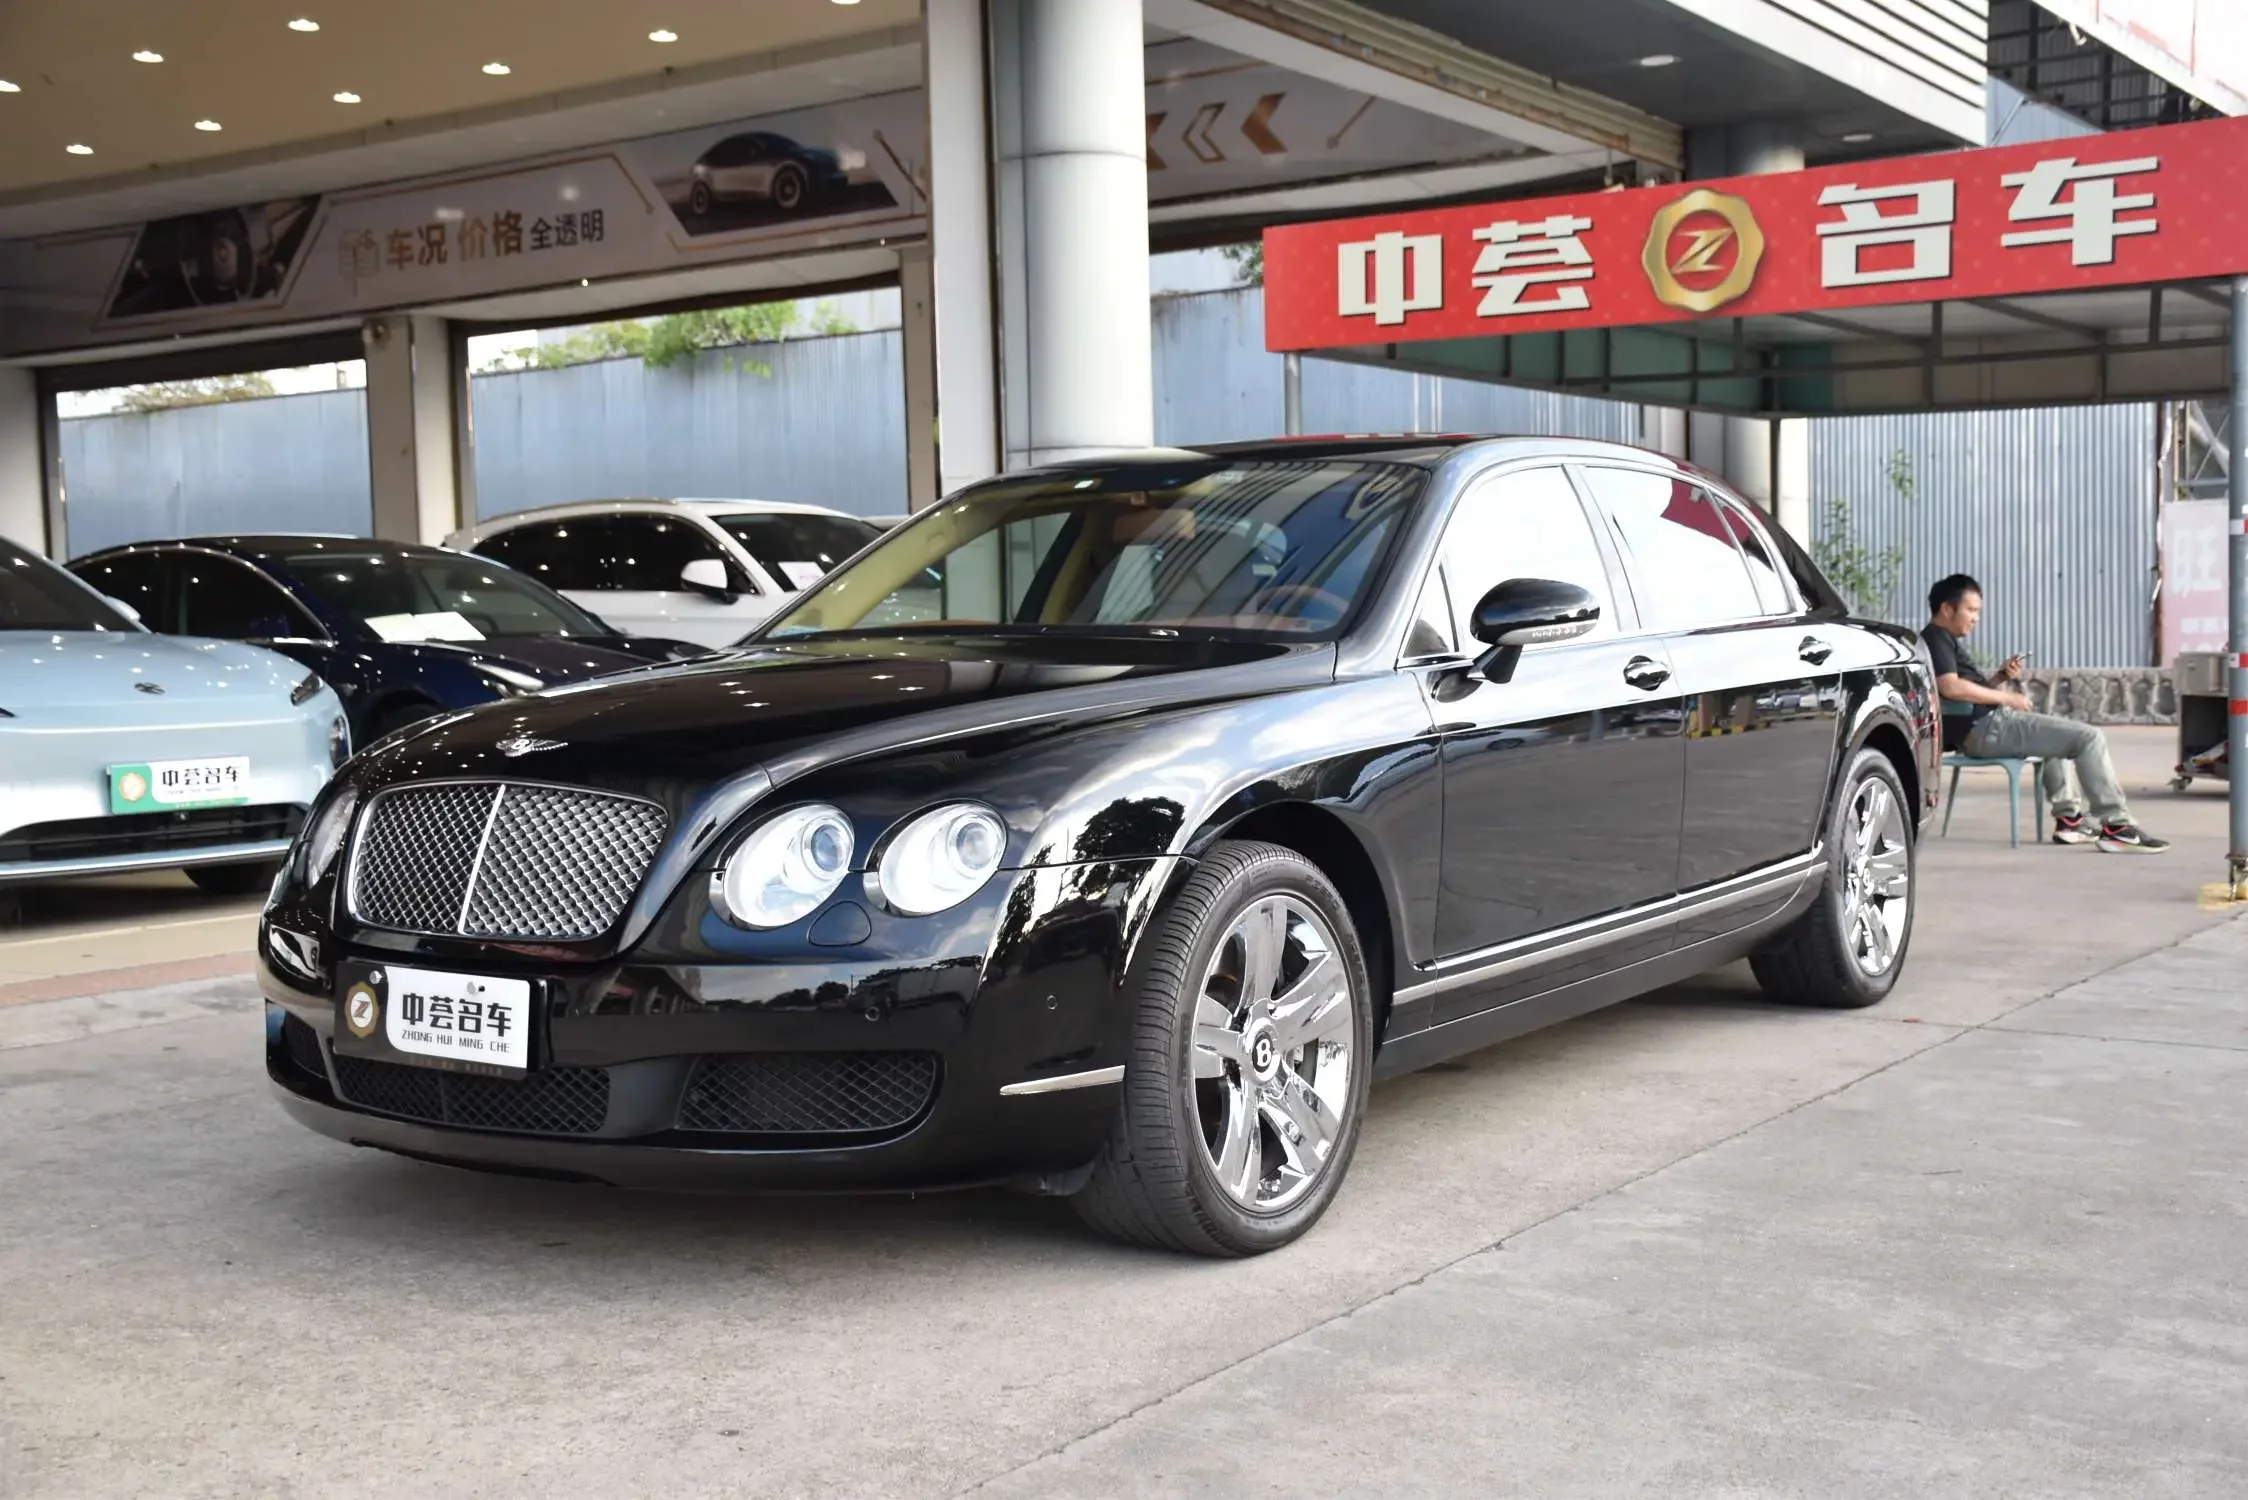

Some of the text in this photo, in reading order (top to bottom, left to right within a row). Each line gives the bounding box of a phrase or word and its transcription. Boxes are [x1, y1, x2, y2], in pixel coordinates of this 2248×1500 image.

[386, 208, 604, 270] 车况 价格 全透明
[1338, 215, 1594, 326] 中荟
[1816, 156, 2159, 288] 名车
[402, 992, 512, 1037] 中荟名车
[401, 1029, 510, 1053] ZHONG HUI MING CHE
[1256, 1038, 1272, 1067] B
